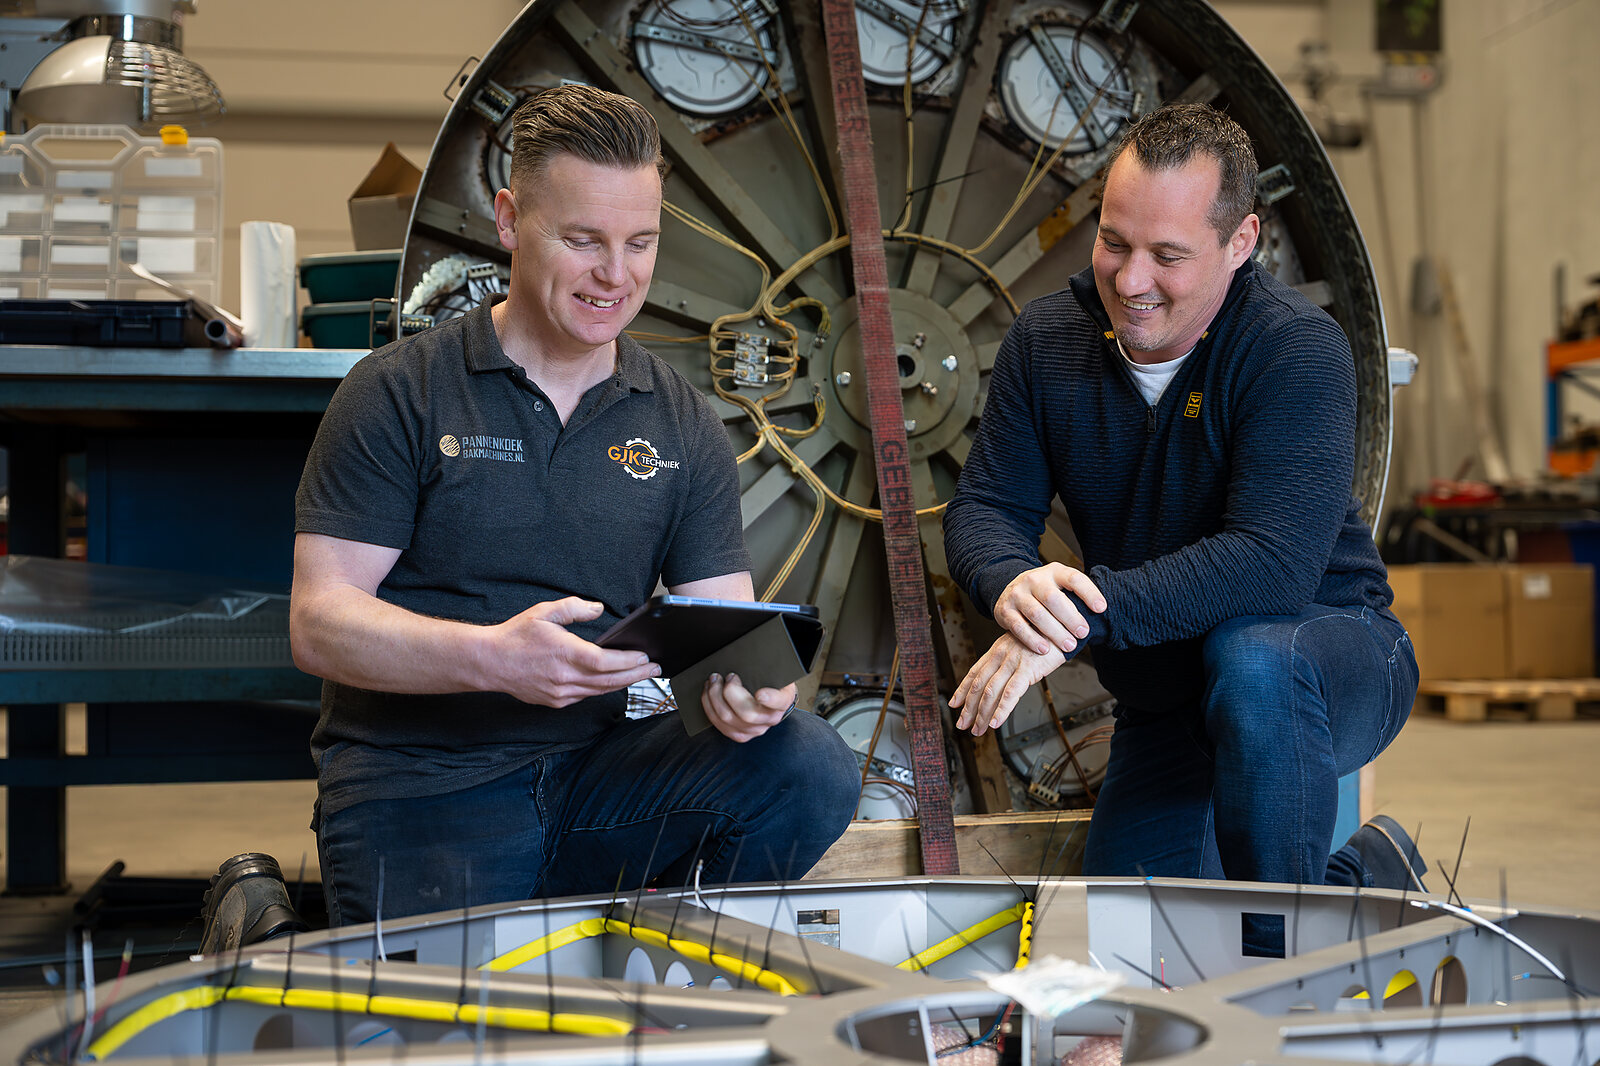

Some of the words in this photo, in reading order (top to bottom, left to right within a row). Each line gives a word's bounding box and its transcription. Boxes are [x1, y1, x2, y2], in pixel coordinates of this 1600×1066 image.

[462, 435, 523, 452] PANNENKOEK
[463, 448, 525, 463] BAKMACHINES.NL
[607, 446, 641, 466] GJK
[641, 456, 680, 470] TECHNIEK
